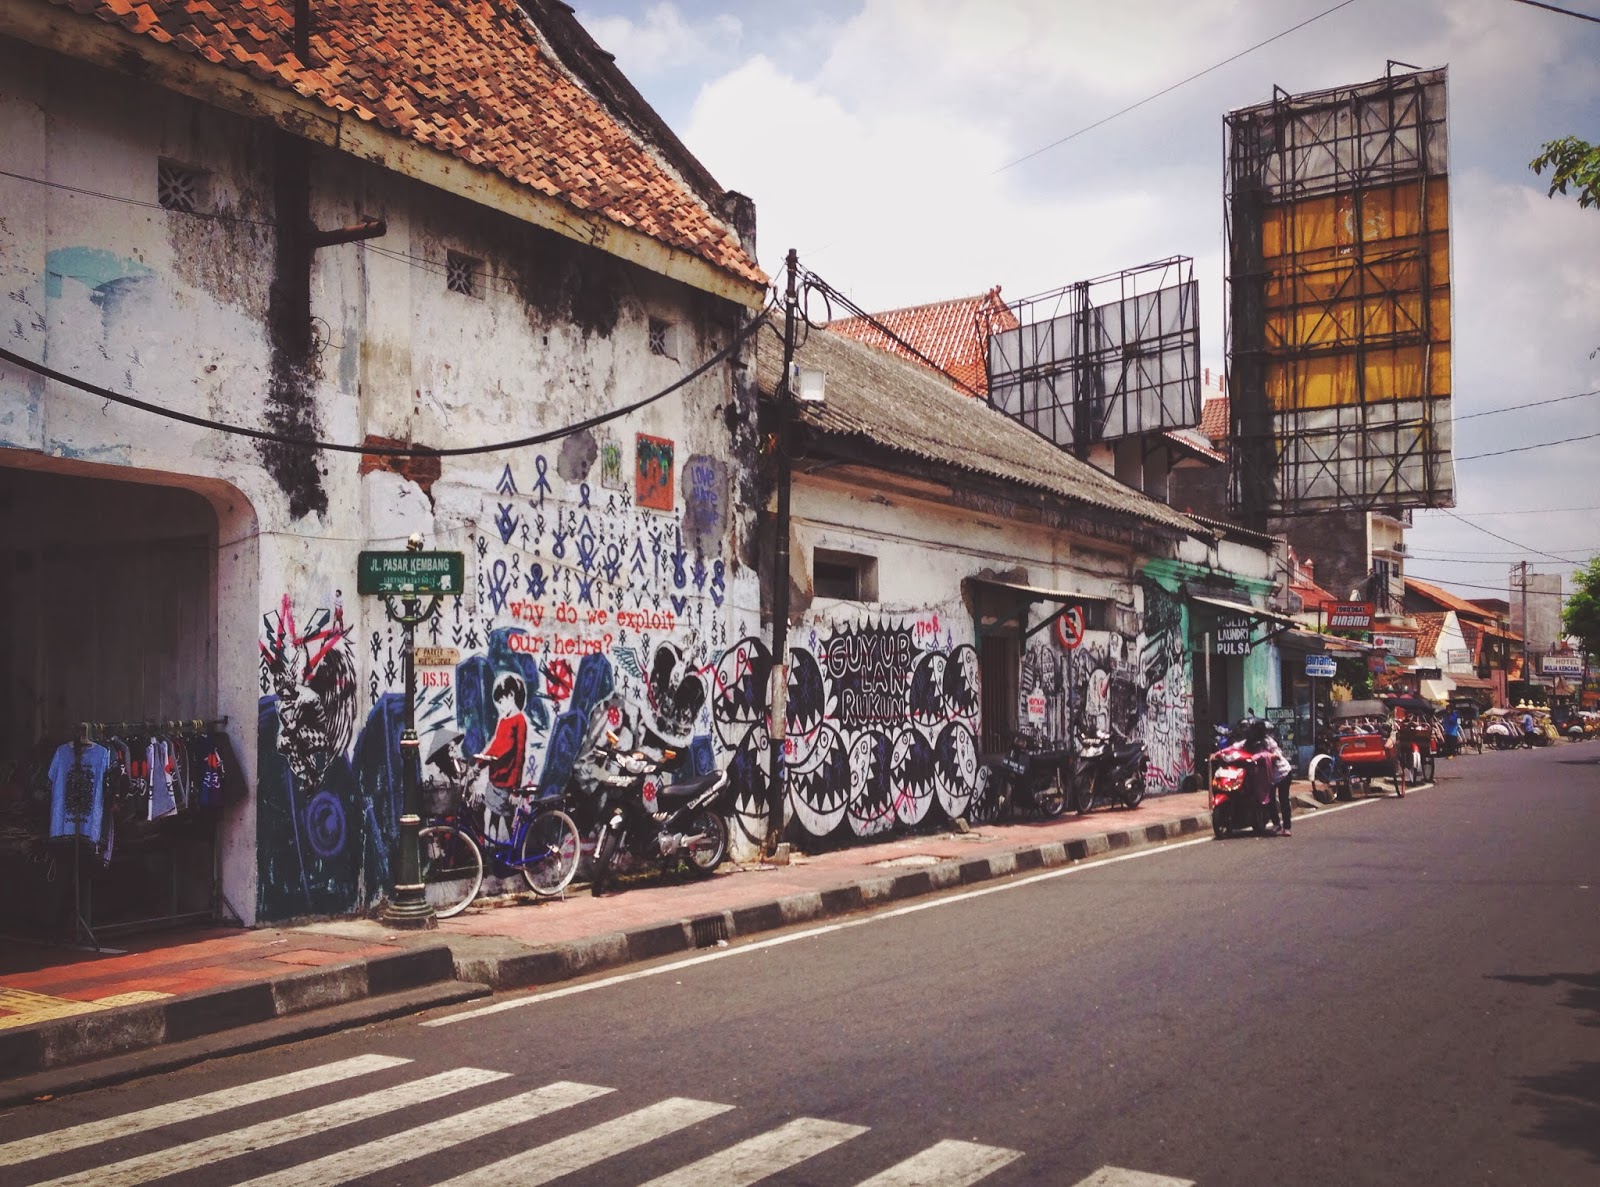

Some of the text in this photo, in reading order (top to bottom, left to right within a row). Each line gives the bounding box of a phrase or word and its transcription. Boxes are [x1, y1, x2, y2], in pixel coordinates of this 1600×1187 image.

[370, 558, 450, 572] JL. PASAR KEMBANG
[509, 599, 676, 634] why do we exploit
[507, 632, 614, 657] our heirs?
[1217, 628, 1249, 641] LAUNDRY
[1216, 642, 1250, 655] PULSA
[861, 662, 905, 695] LAN
[841, 688, 905, 727] RUKUN
